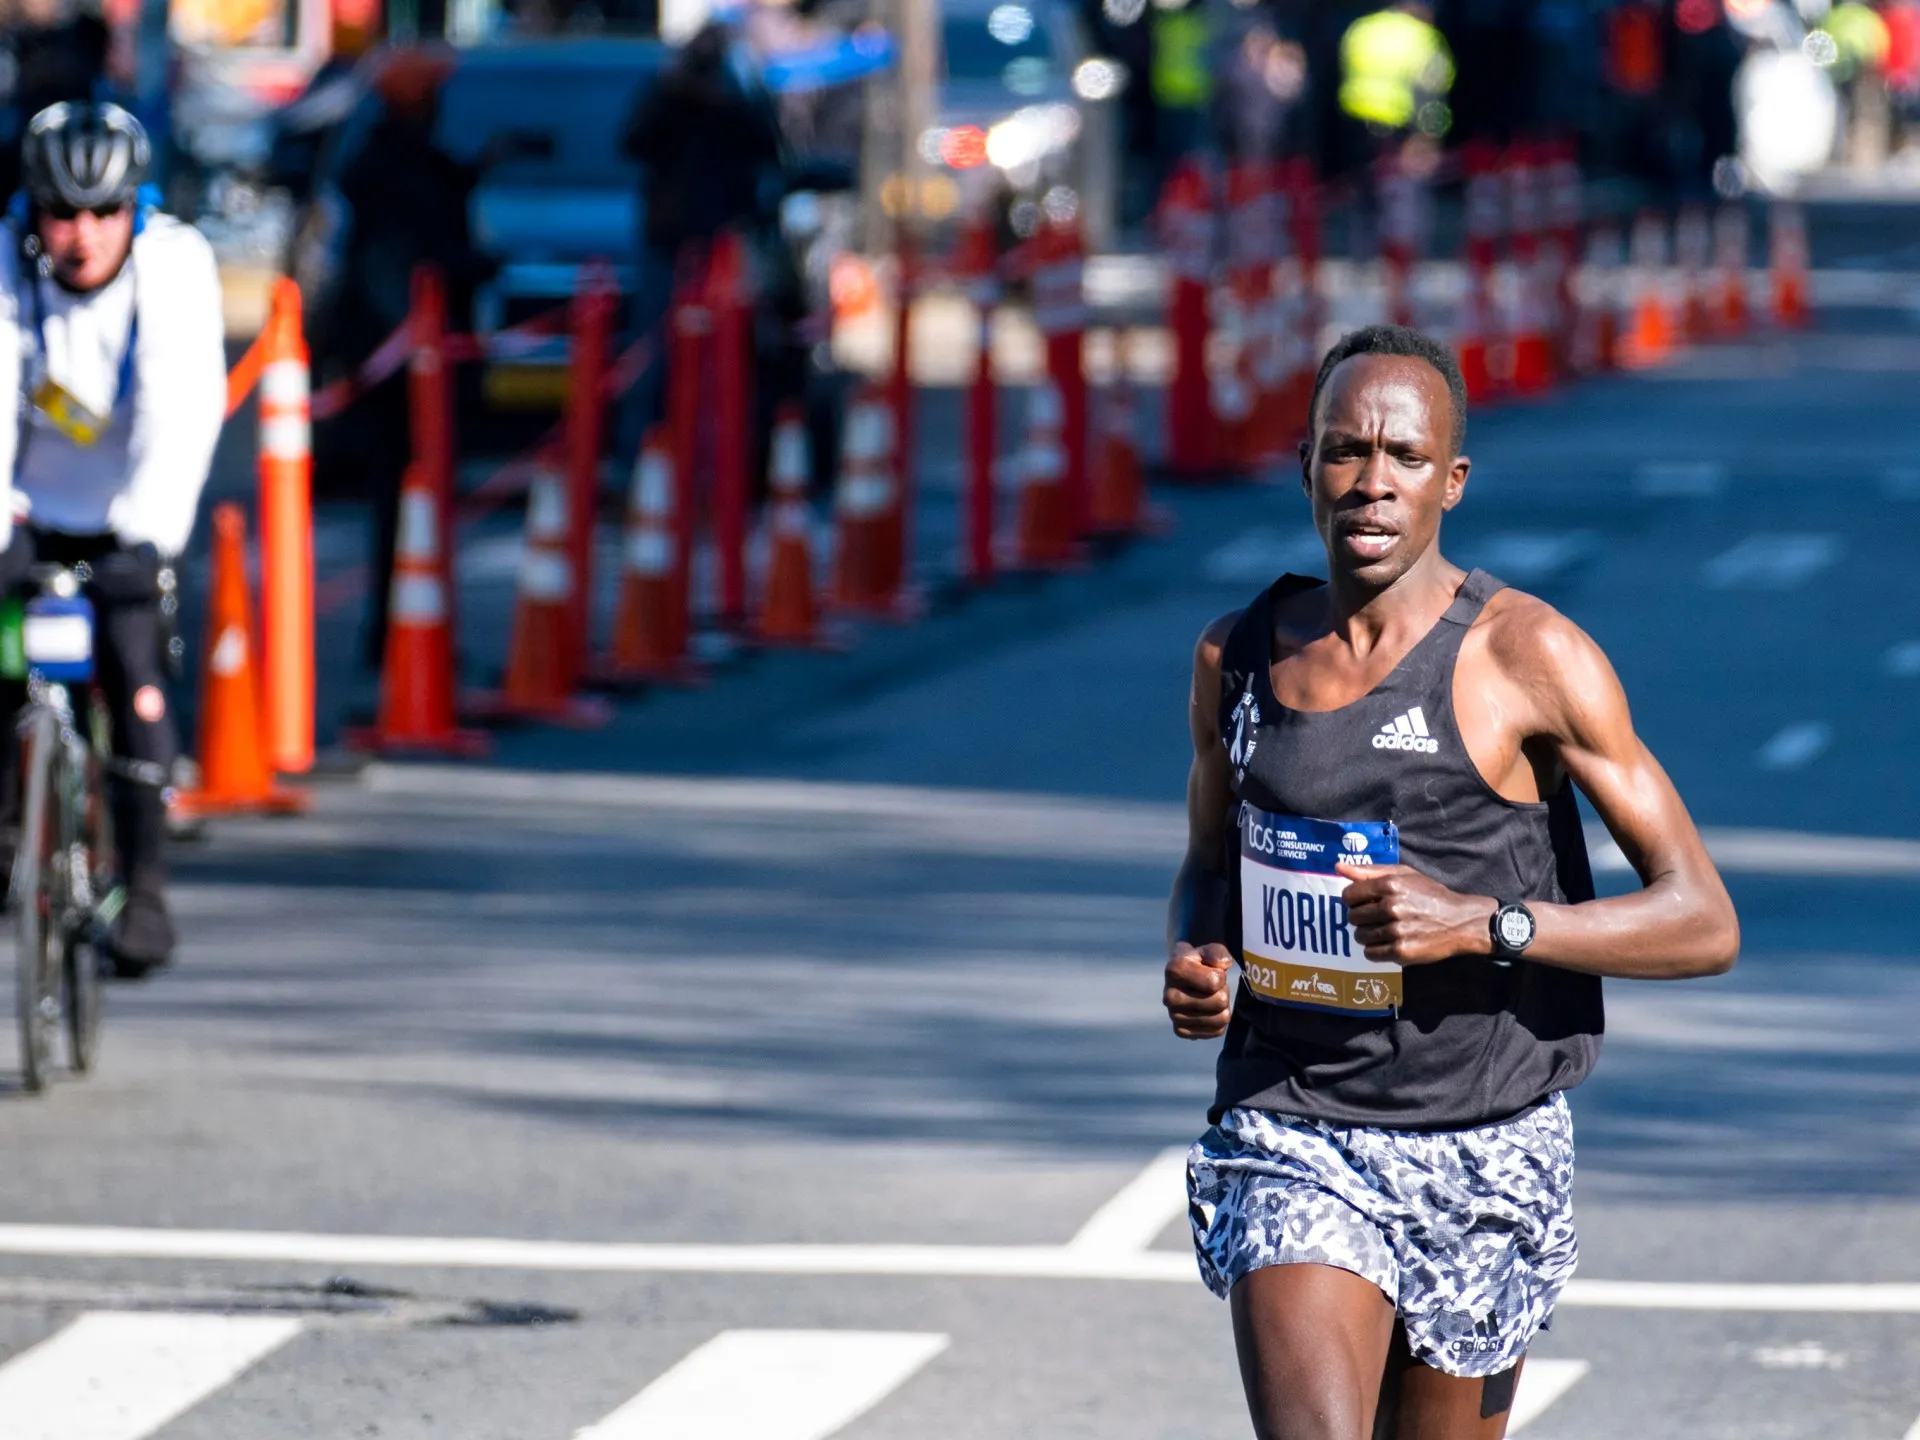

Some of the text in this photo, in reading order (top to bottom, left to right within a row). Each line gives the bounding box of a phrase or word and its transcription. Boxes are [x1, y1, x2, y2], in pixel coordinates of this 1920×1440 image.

[1372, 731, 1438, 753] adidas
[1248, 814, 1275, 854] tcs
[1276, 830, 1298, 840] TATA
[1276, 839, 1325, 853] CONSULTANCY
[1276, 848, 1308, 860] SERVICES
[1337, 853, 1373, 865] TATA
[1262, 883, 1351, 957] KORIR
[1245, 961, 1277, 990] 2021
[1451, 1337, 1505, 1353] adidas
